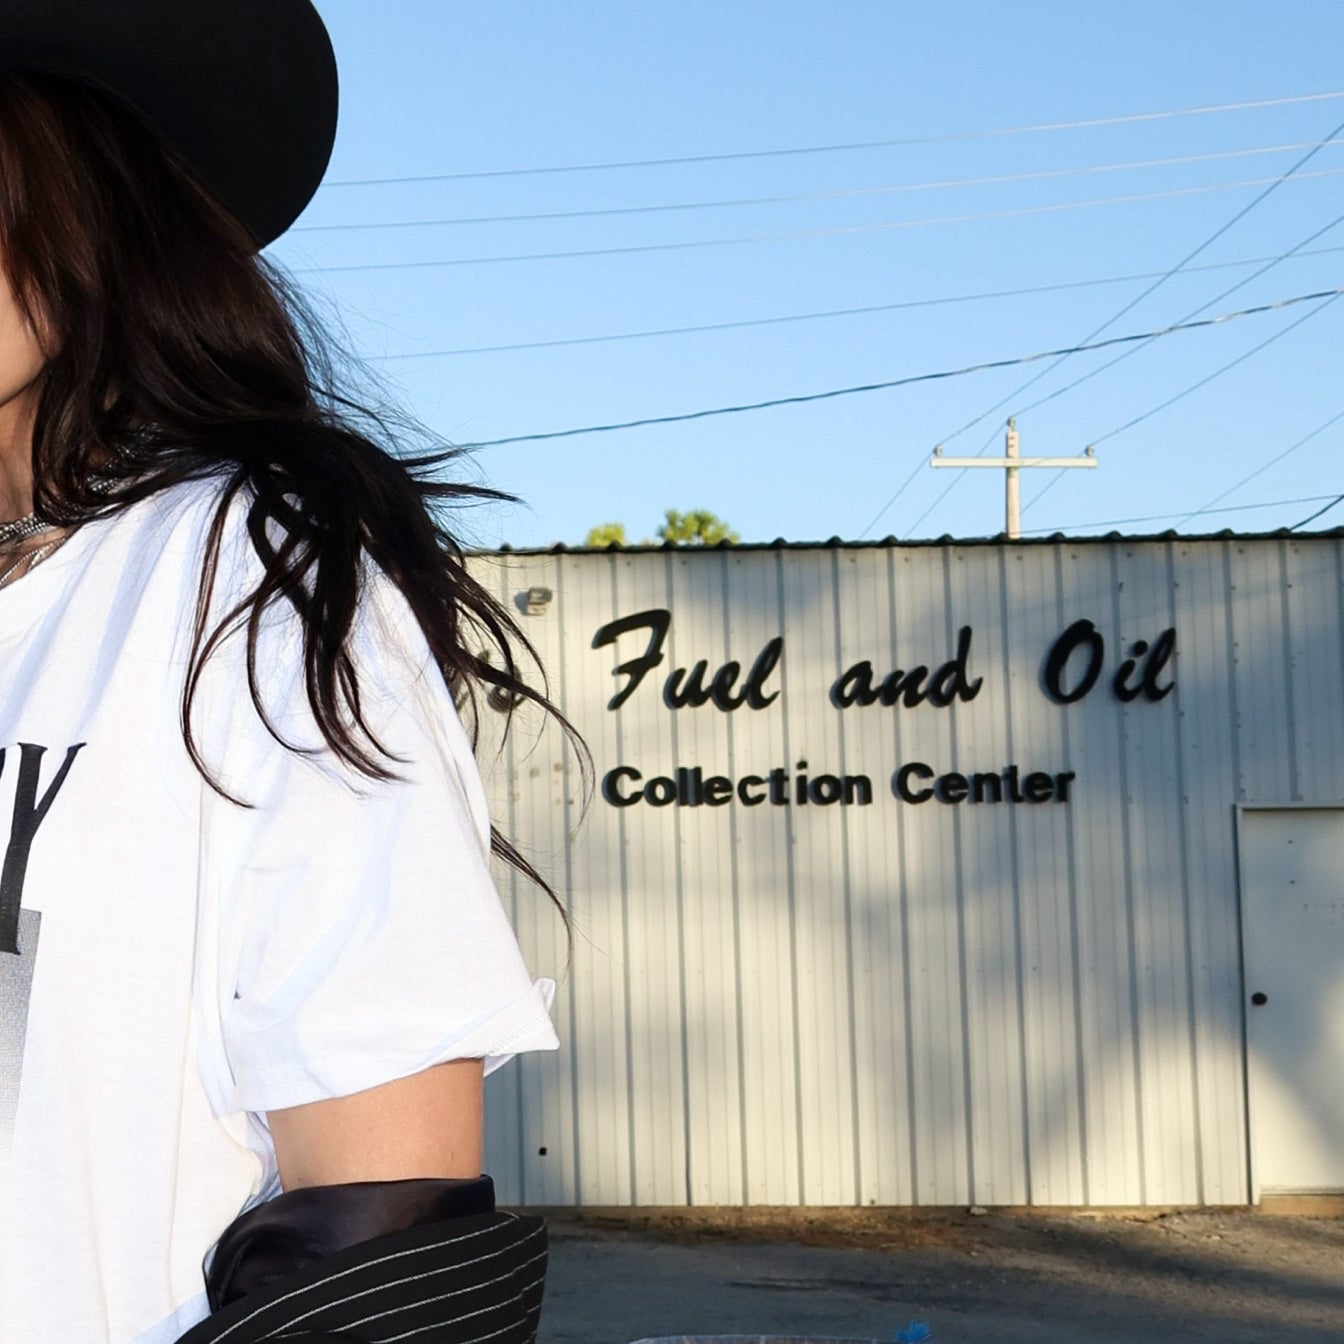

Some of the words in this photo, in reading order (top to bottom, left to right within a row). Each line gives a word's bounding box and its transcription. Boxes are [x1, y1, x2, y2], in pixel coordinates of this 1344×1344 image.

[591, 608, 784, 712] Fuel
[830, 624, 984, 708] and
[1040, 618, 1177, 705] Oil
[602, 758, 873, 807] Collection
[892, 762, 1076, 806] Center
